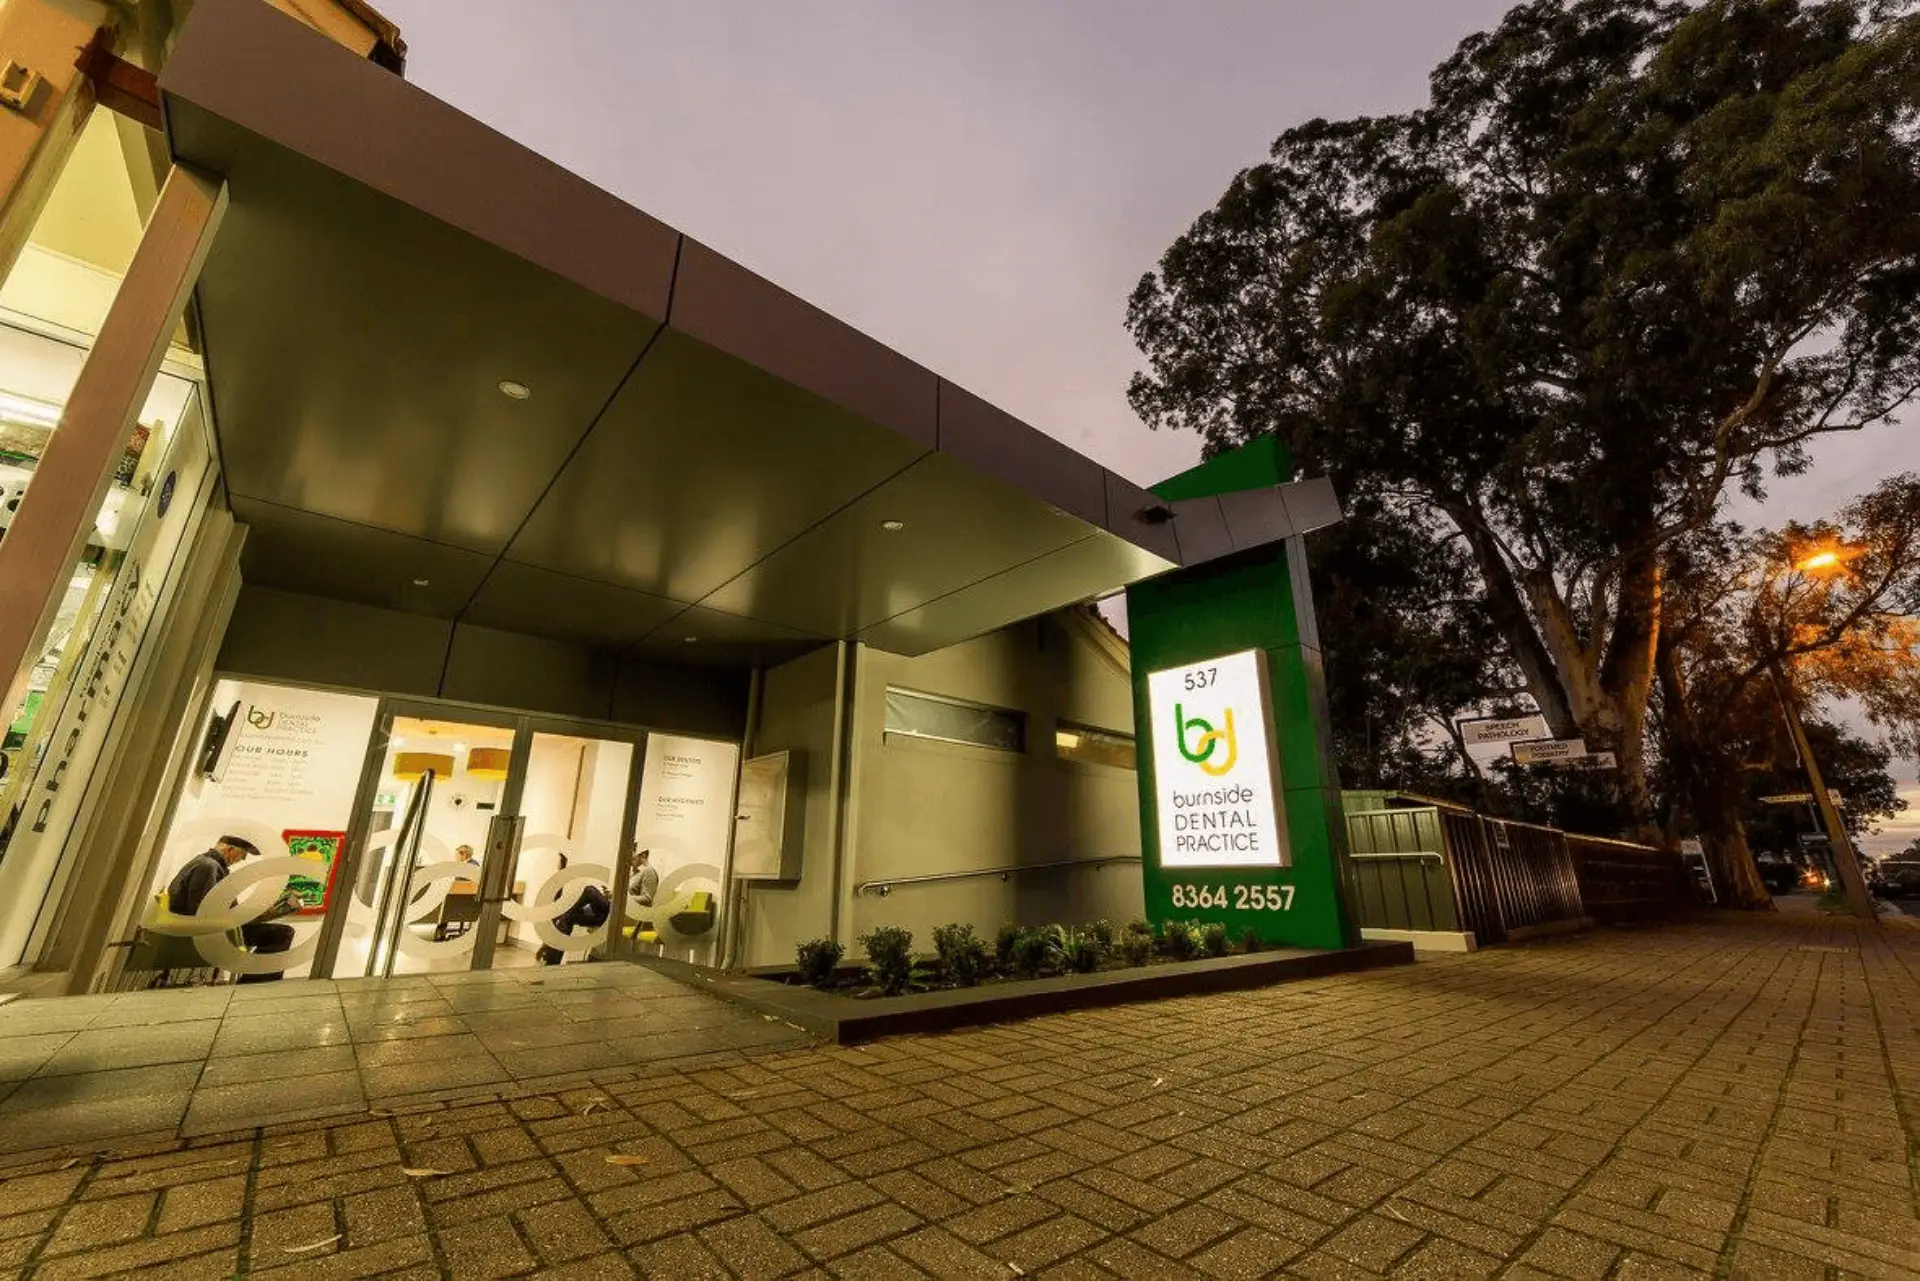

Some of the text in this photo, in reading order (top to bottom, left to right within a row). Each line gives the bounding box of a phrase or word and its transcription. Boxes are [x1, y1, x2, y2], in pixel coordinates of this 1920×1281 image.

[1184, 667, 1217, 691] 537
[32, 562, 140, 833] pharmacy
[1477, 728, 1529, 739] PATHOLOGY
[1485, 722, 1519, 731] SPEECH
[235, 745, 308, 757] OUR HOURS
[1173, 784, 1253, 808] burnside
[1175, 810, 1257, 831] DENTAL
[1176, 832, 1259, 852] PRACTICE
[1172, 884, 1295, 911] 8364 2557
